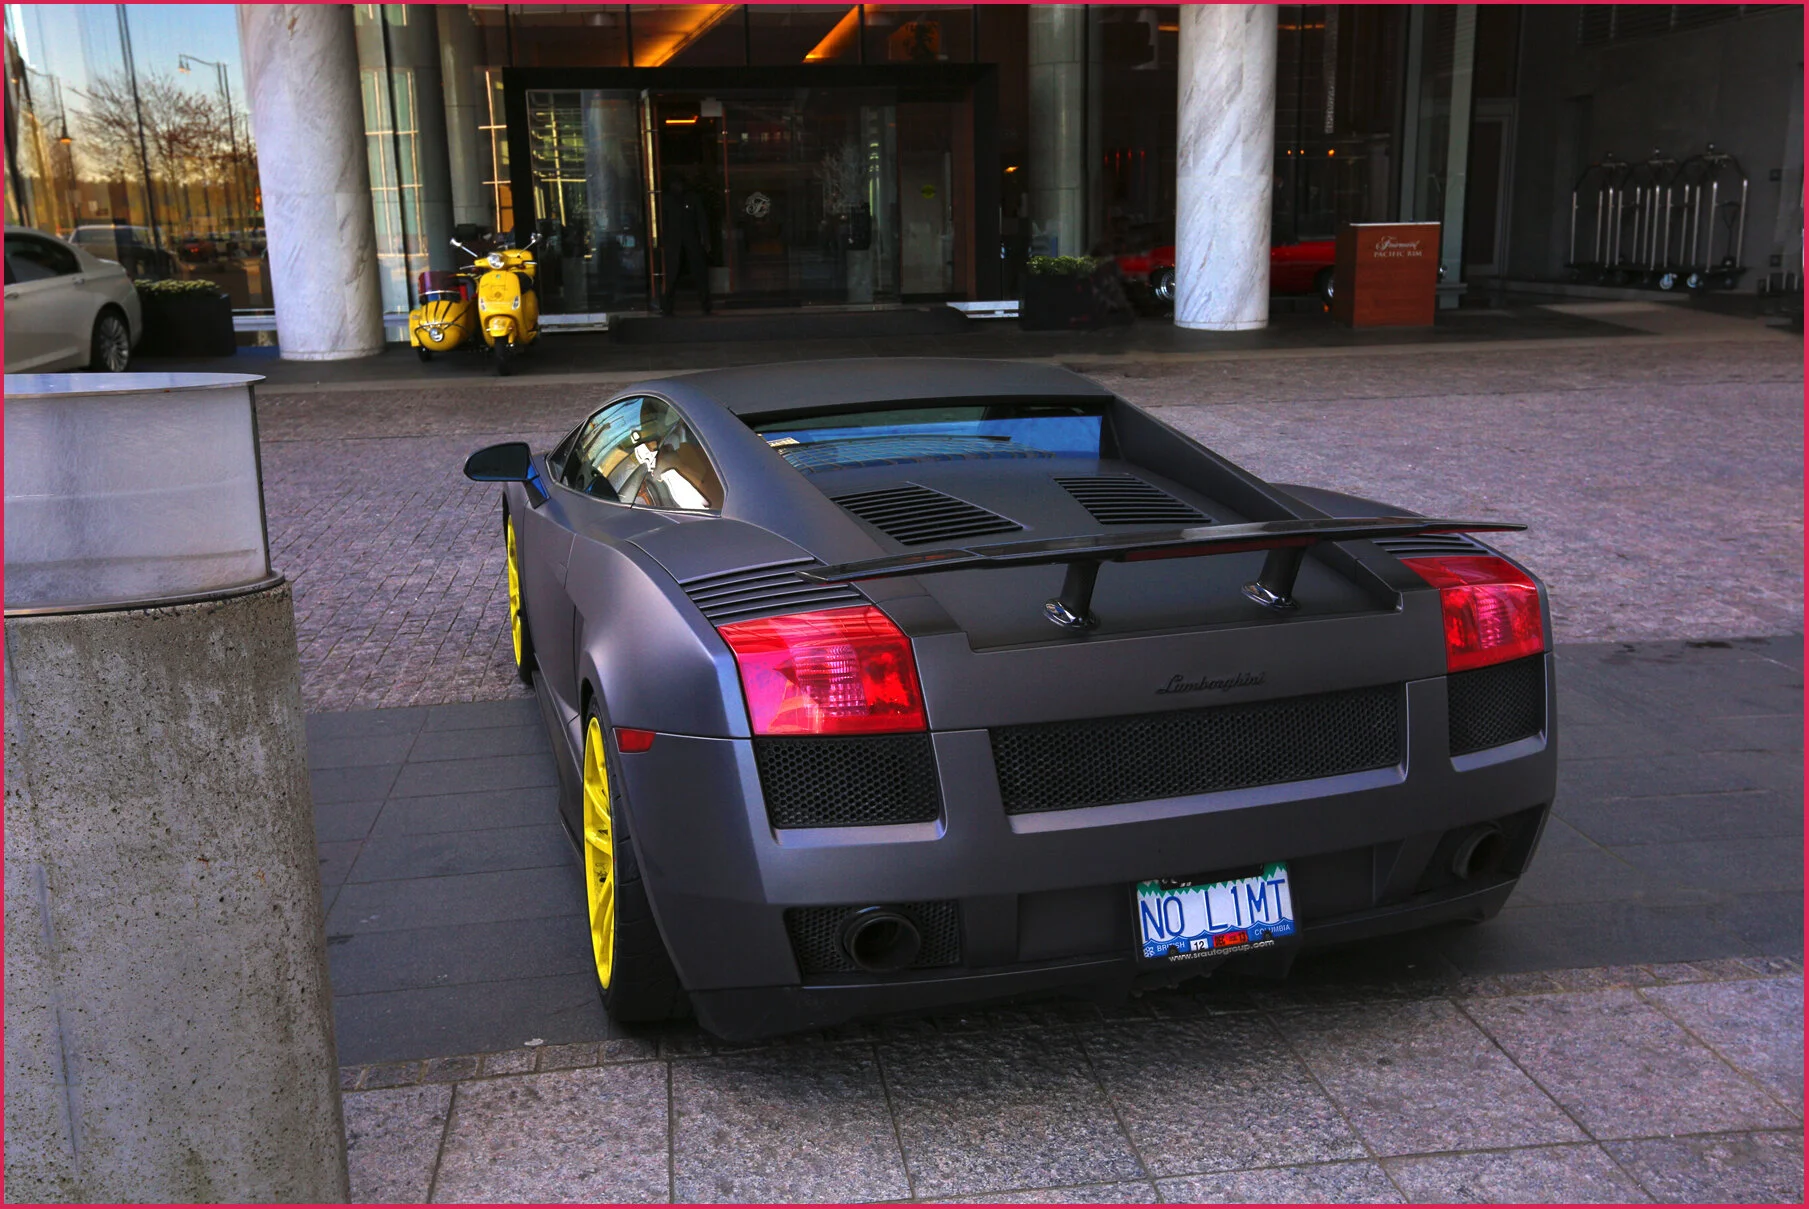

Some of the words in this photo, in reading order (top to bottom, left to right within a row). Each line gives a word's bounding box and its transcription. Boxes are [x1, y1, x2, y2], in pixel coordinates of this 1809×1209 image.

[1155, 672, 1265, 694] Lamborghini
[1141, 896, 1185, 942] NO
[1204, 879, 1285, 931] L1MT
[1156, 941, 1185, 952] BRISH
[1168, 939, 1275, 962] www.srautogroup.com
[1194, 940, 1205, 951] 12
